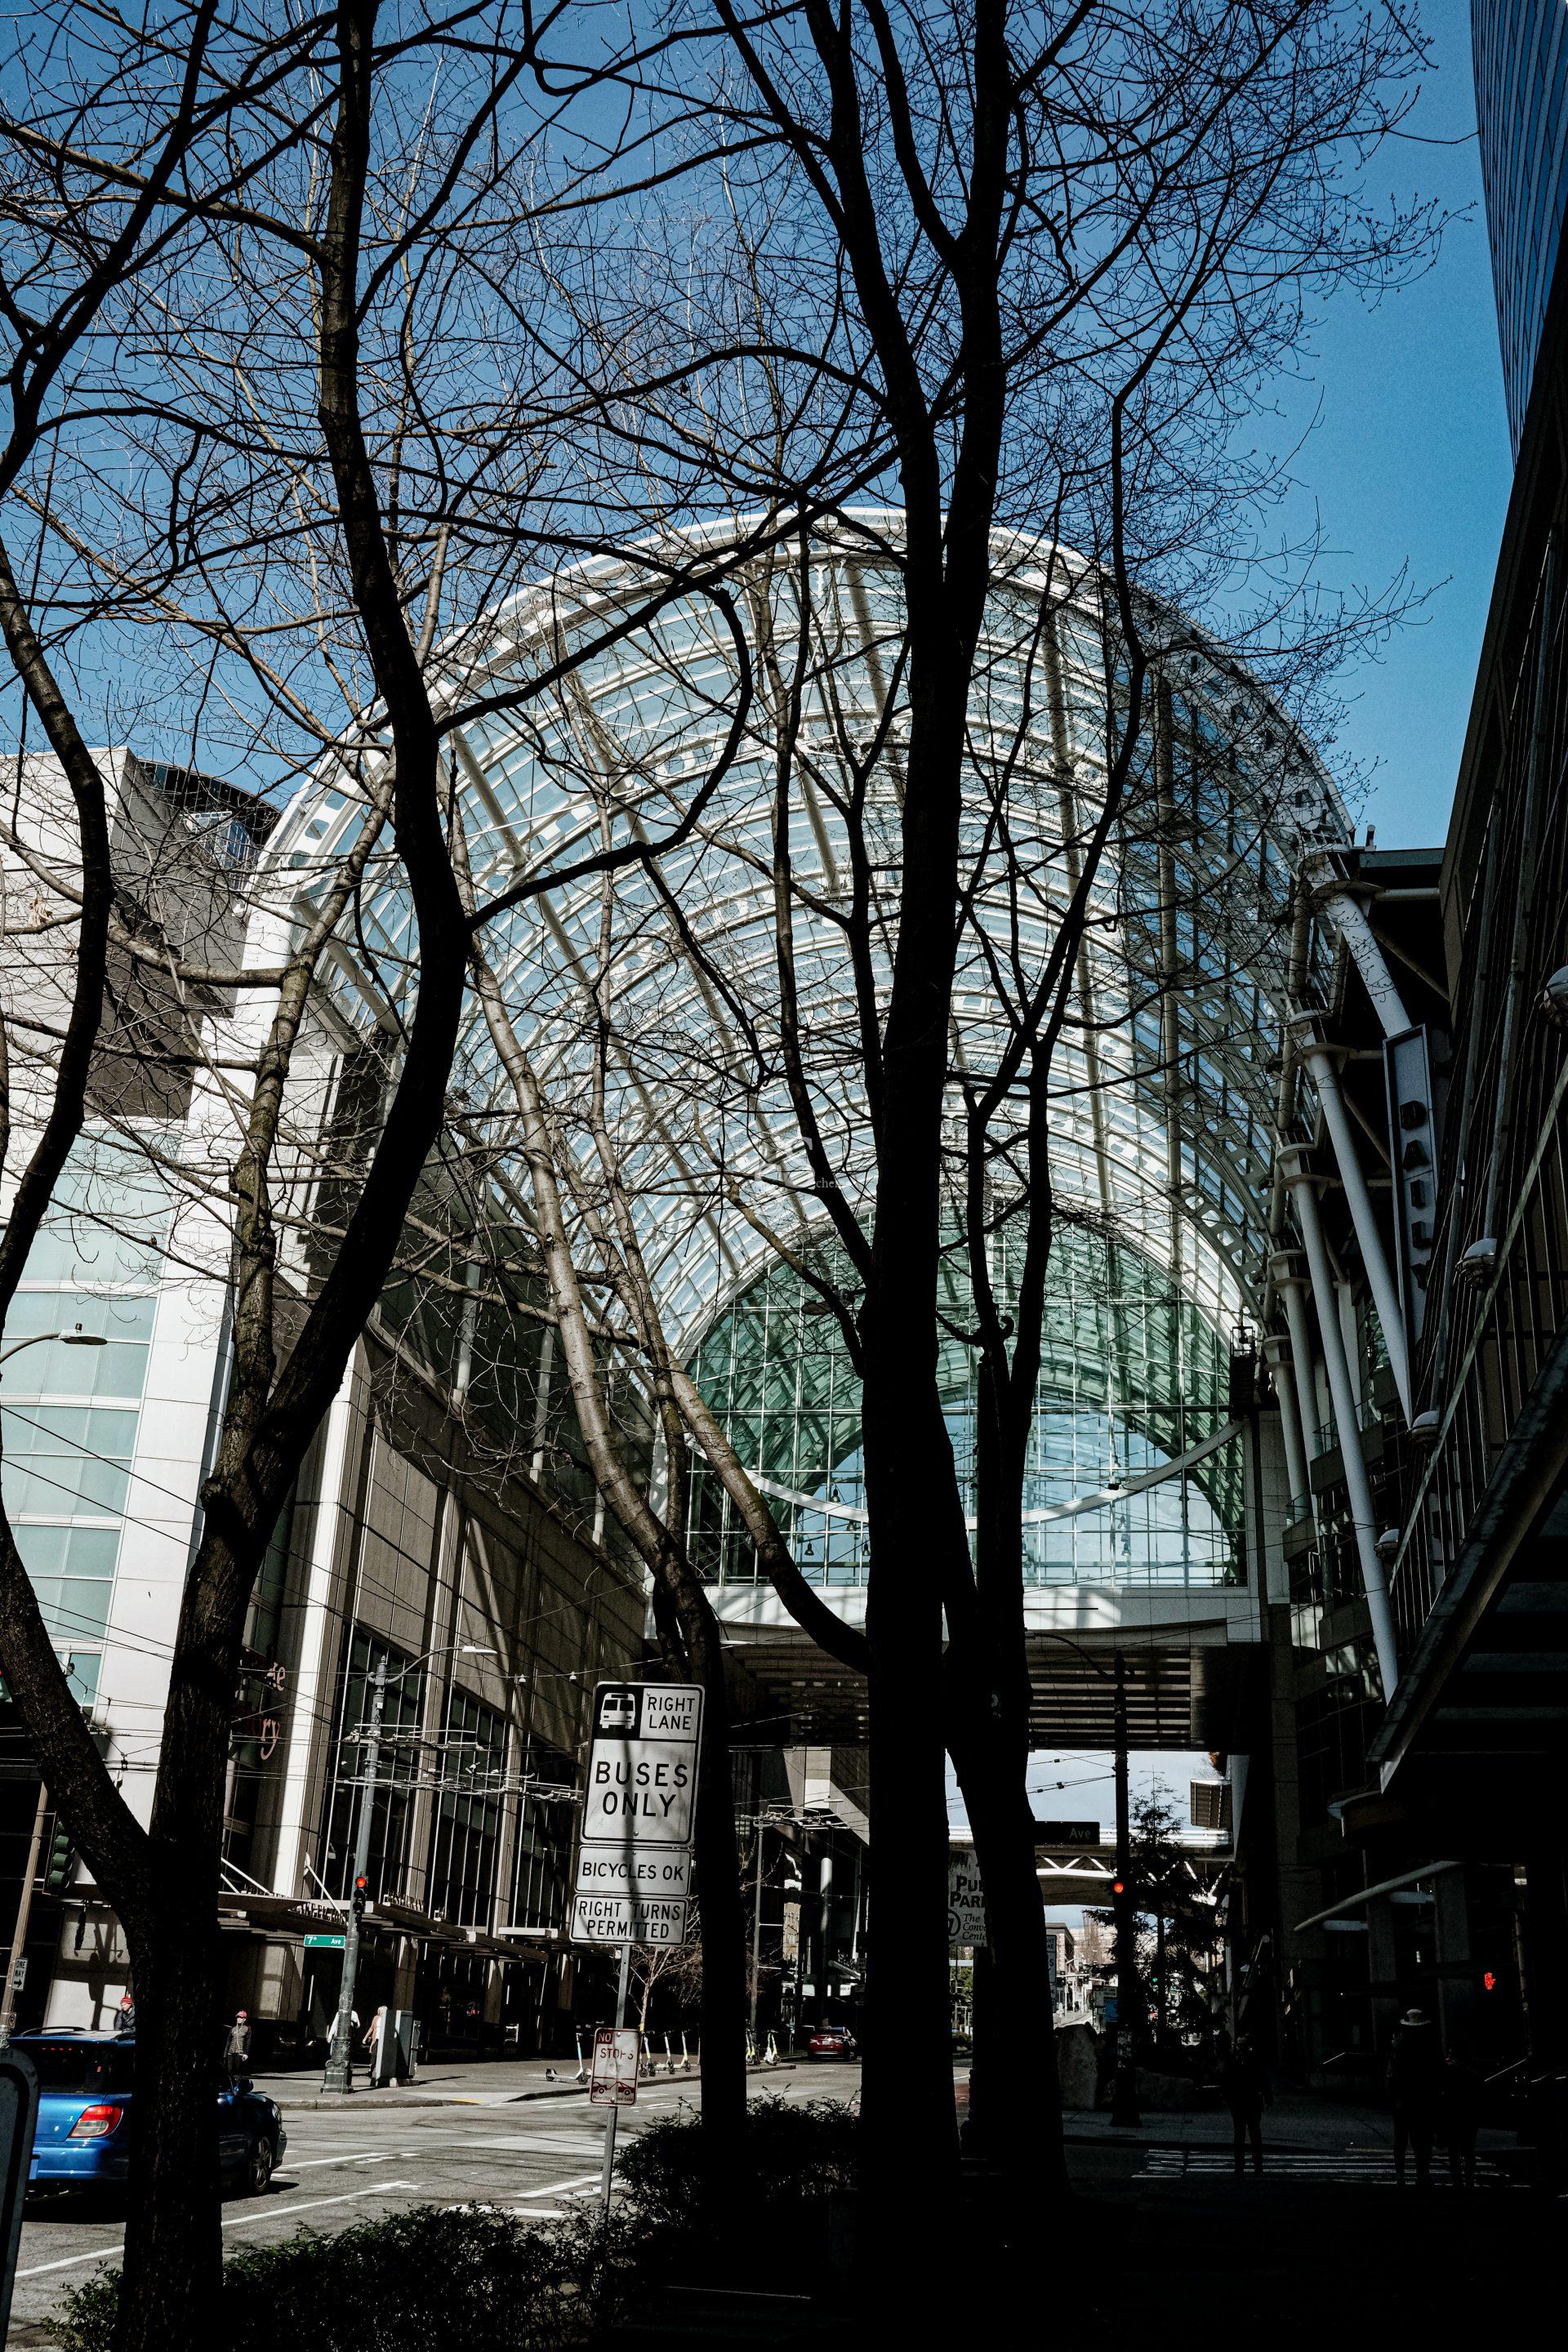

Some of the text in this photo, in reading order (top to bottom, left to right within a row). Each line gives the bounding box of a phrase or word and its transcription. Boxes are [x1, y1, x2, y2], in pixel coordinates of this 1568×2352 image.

[648, 1696, 695, 1712] RIGHT
[649, 1715, 692, 1730] LANE
[595, 1761, 688, 1788] BUSES
[603, 1791, 677, 1818] ONLY
[1069, 1828, 1091, 1839] Ave
[581, 1862, 684, 1882] BICYCLES OK
[578, 1900, 681, 1921] RIGHT TURNS
[963, 1913, 980, 1922] The
[586, 1920, 670, 1940] PERMITTED
[330, 1937, 341, 1945] Ave
[15, 1960, 26, 1969] ONE
[14, 1969, 24, 1977] WAY
[598, 2032, 612, 2042] NO
